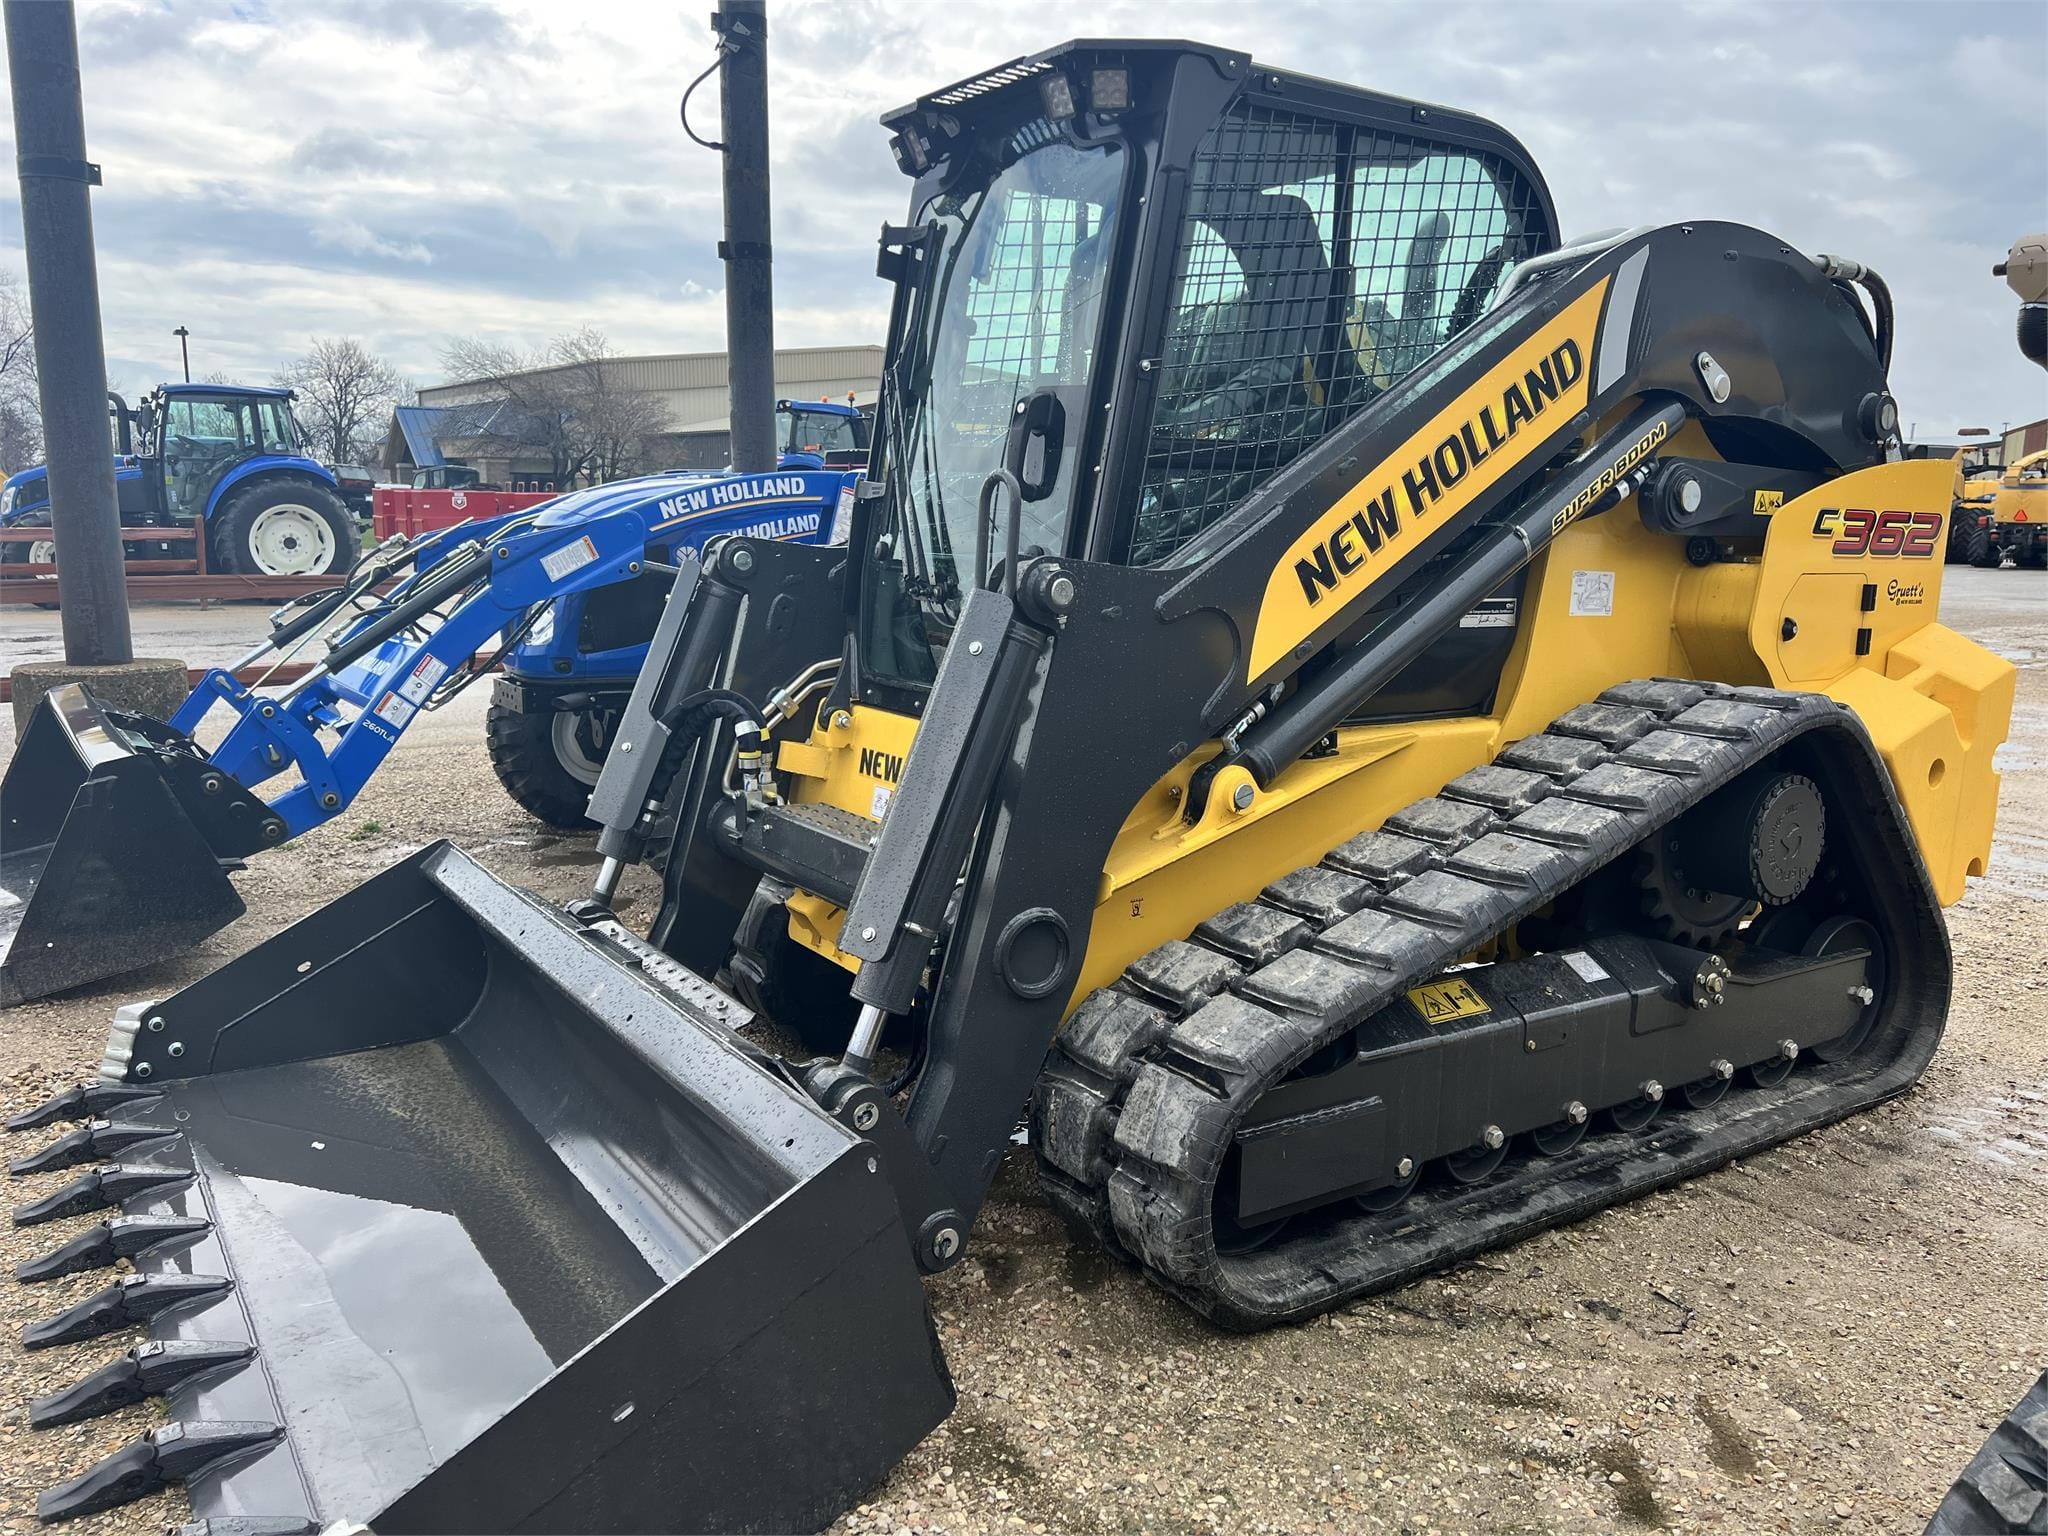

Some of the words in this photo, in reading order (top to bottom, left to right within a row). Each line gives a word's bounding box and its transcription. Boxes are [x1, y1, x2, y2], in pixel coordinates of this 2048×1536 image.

[1294, 485, 1400, 606] NEW
[1401, 338, 1584, 518] HOLLAND
[1552, 468, 1614, 536] SUPER
[1614, 421, 1667, 480] BOOM
[658, 490, 708, 520] NEW
[711, 477, 806, 505] HOLLAND
[1812, 508, 1943, 557] C362
[1887, 579, 1924, 602] Gruett's
[362, 719, 396, 743] 260TLA
[859, 747, 903, 784] NEW
